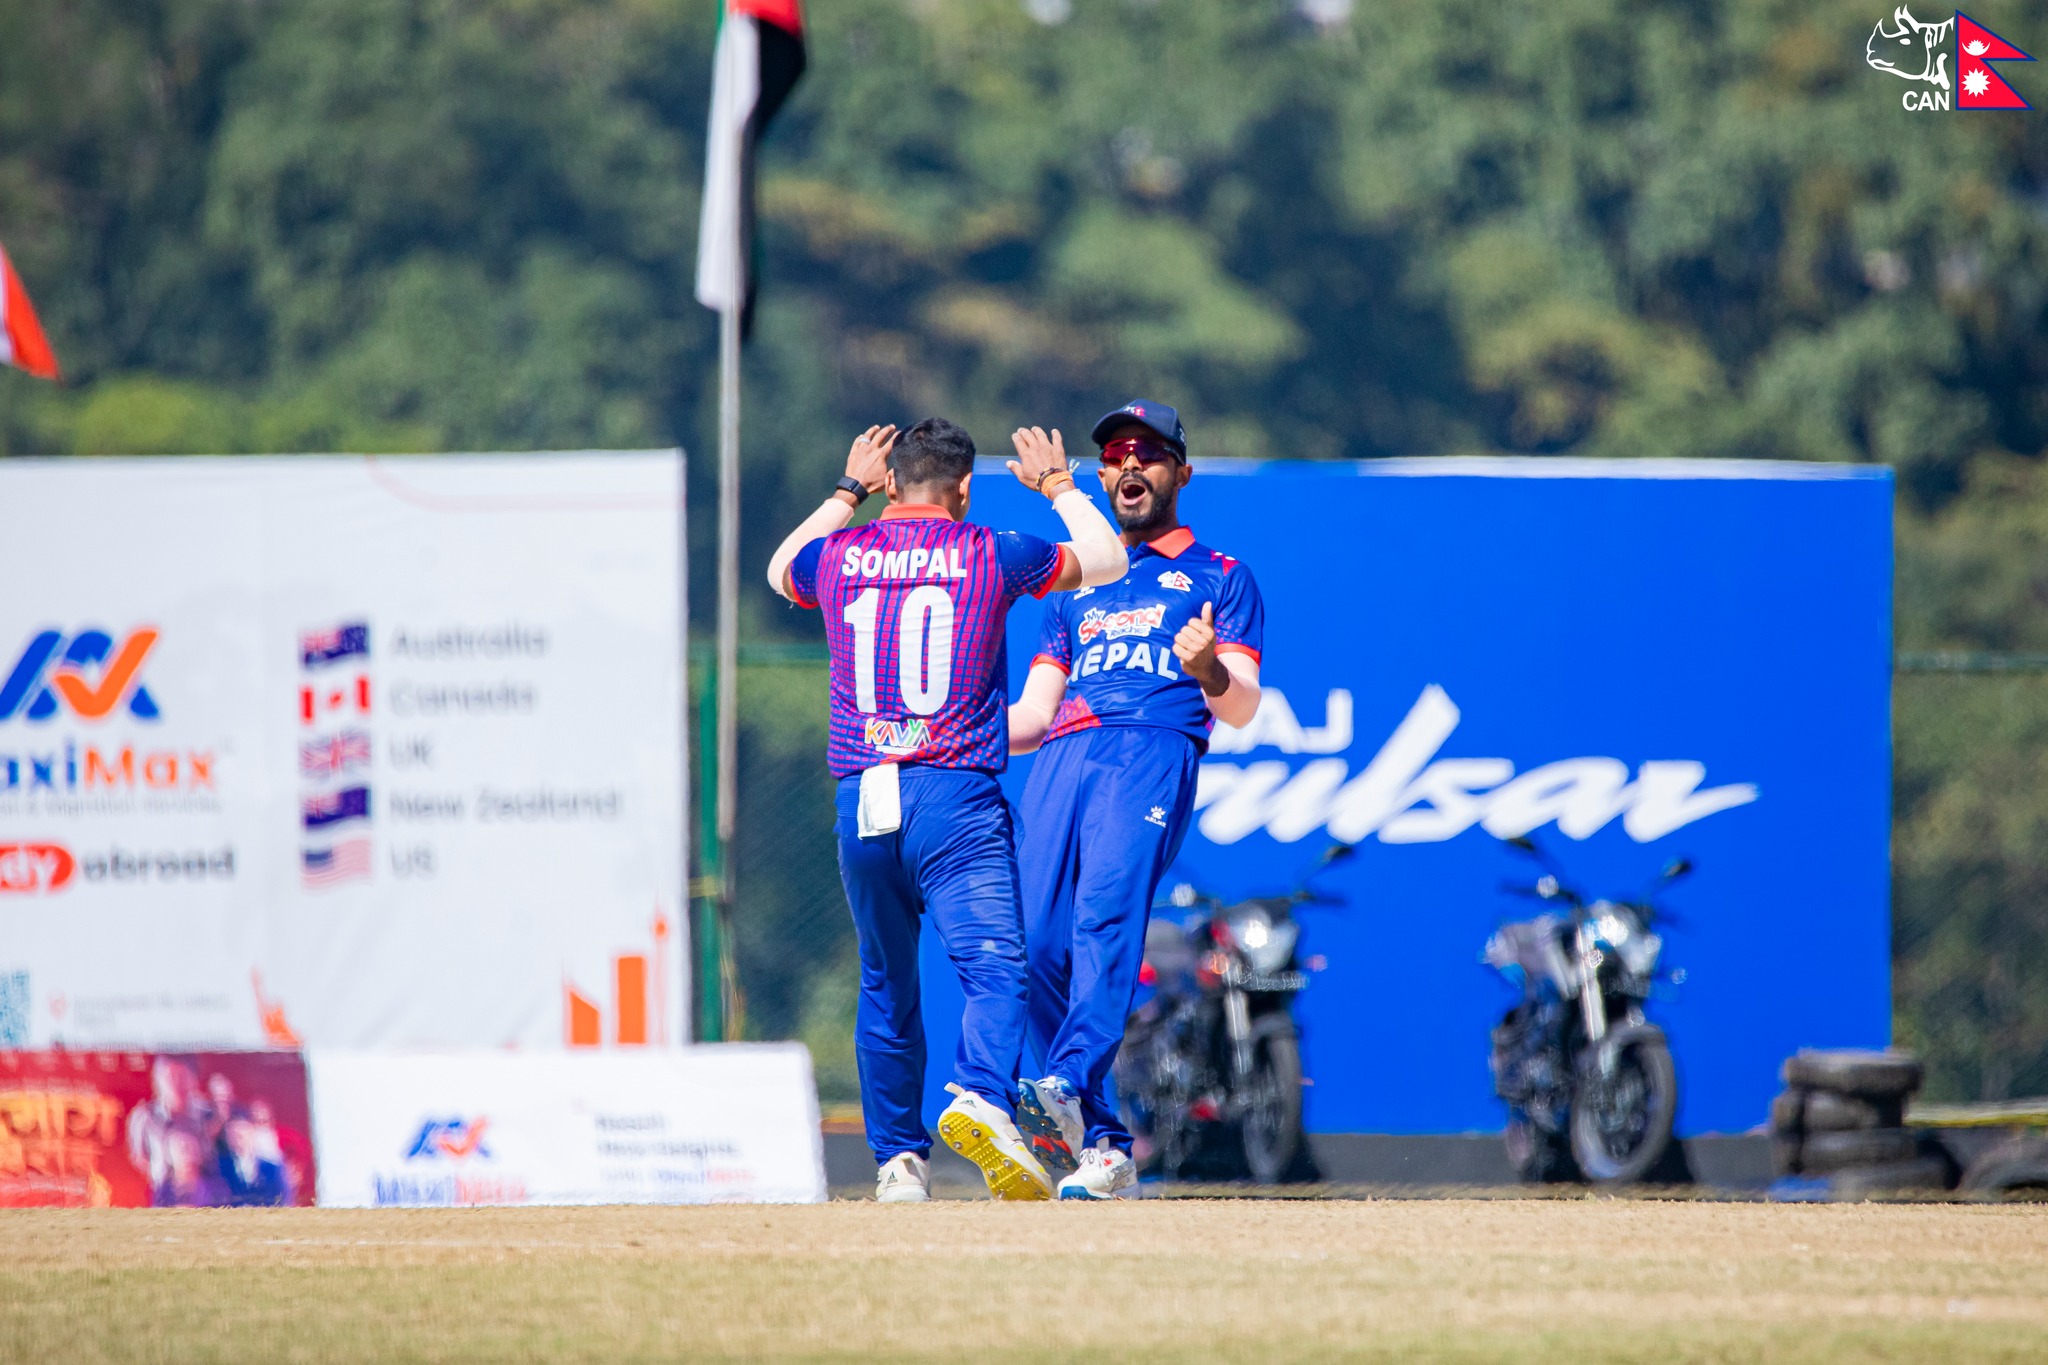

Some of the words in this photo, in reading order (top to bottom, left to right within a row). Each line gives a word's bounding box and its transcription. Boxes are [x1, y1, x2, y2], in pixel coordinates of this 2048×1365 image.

[841, 546, 968, 579] SOMPAL
[391, 622, 550, 659] Australia
[844, 584, 954, 716] 10
[390, 677, 538, 716] Canada
[390, 735, 434, 770] UK
[1193, 684, 1762, 845] ulsar
[390, 790, 464, 823] New
[474, 786, 623, 823] Zealand
[390, 842, 437, 878] US
